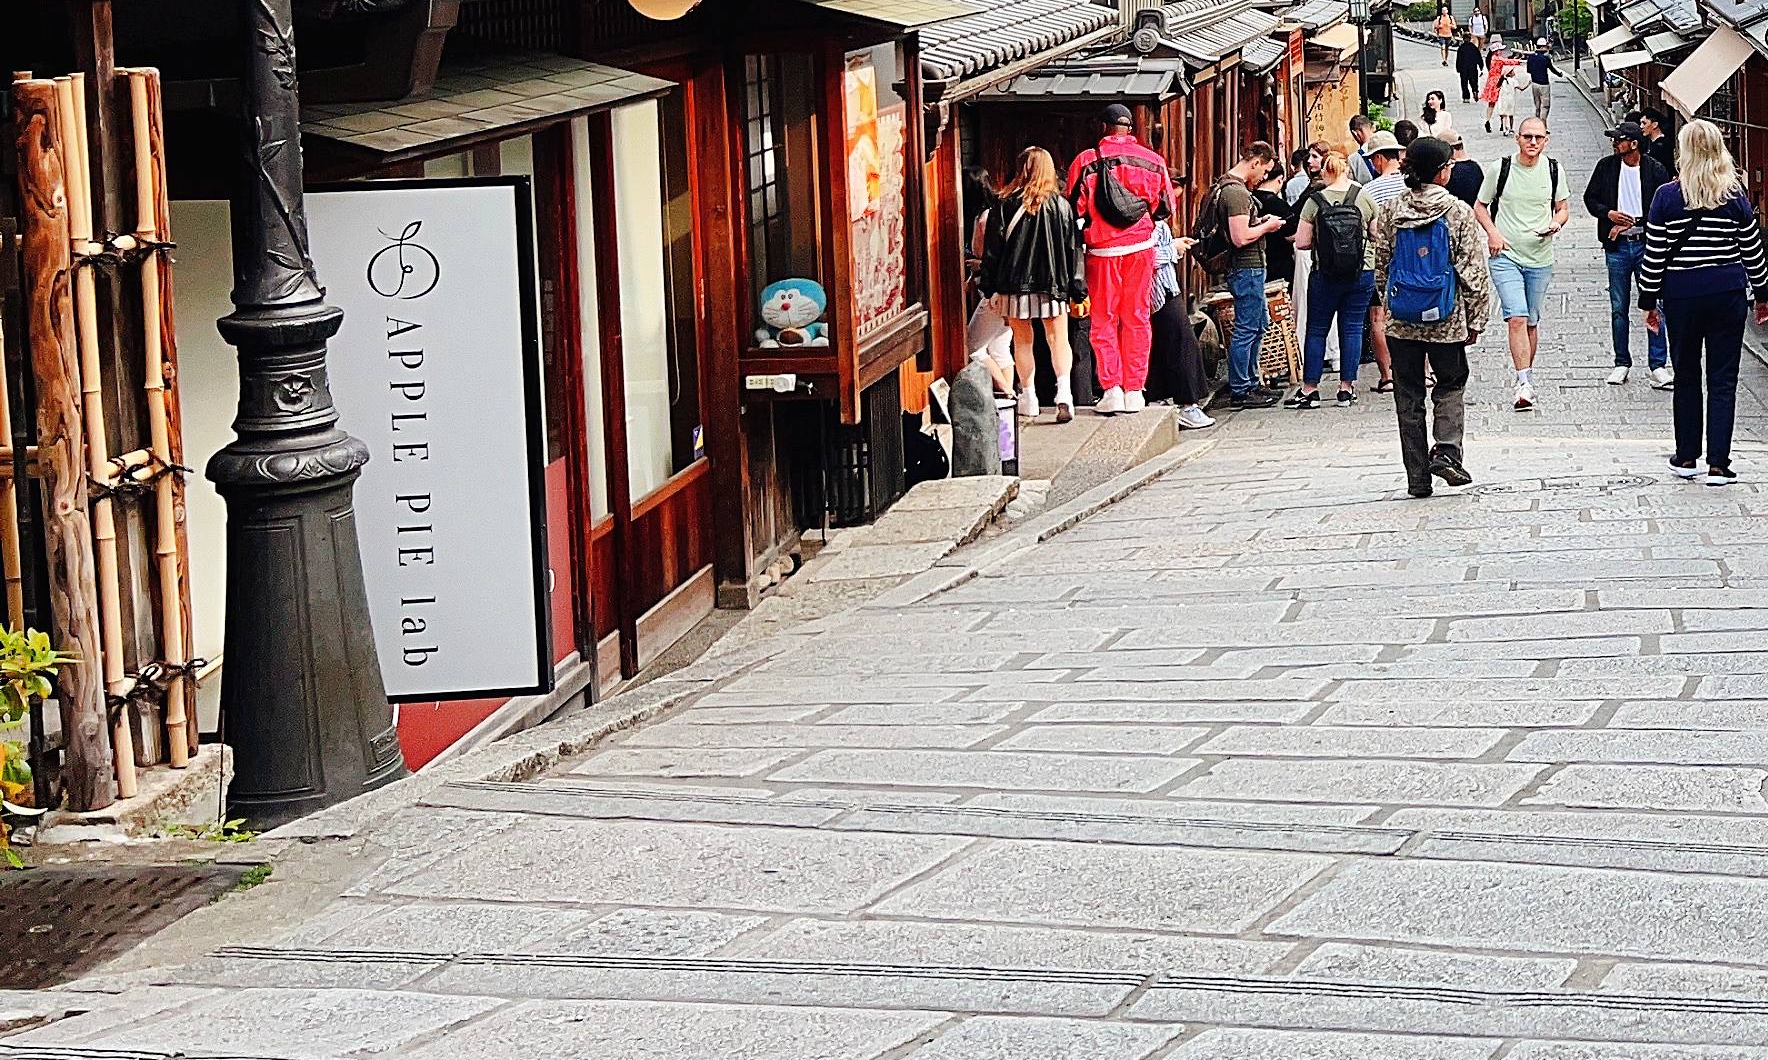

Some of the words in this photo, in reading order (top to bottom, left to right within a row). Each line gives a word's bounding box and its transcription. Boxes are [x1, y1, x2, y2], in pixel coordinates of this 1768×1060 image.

[386, 316, 429, 462] APPLE
[395, 492, 434, 567] PIE
[401, 595, 439, 667] lab
